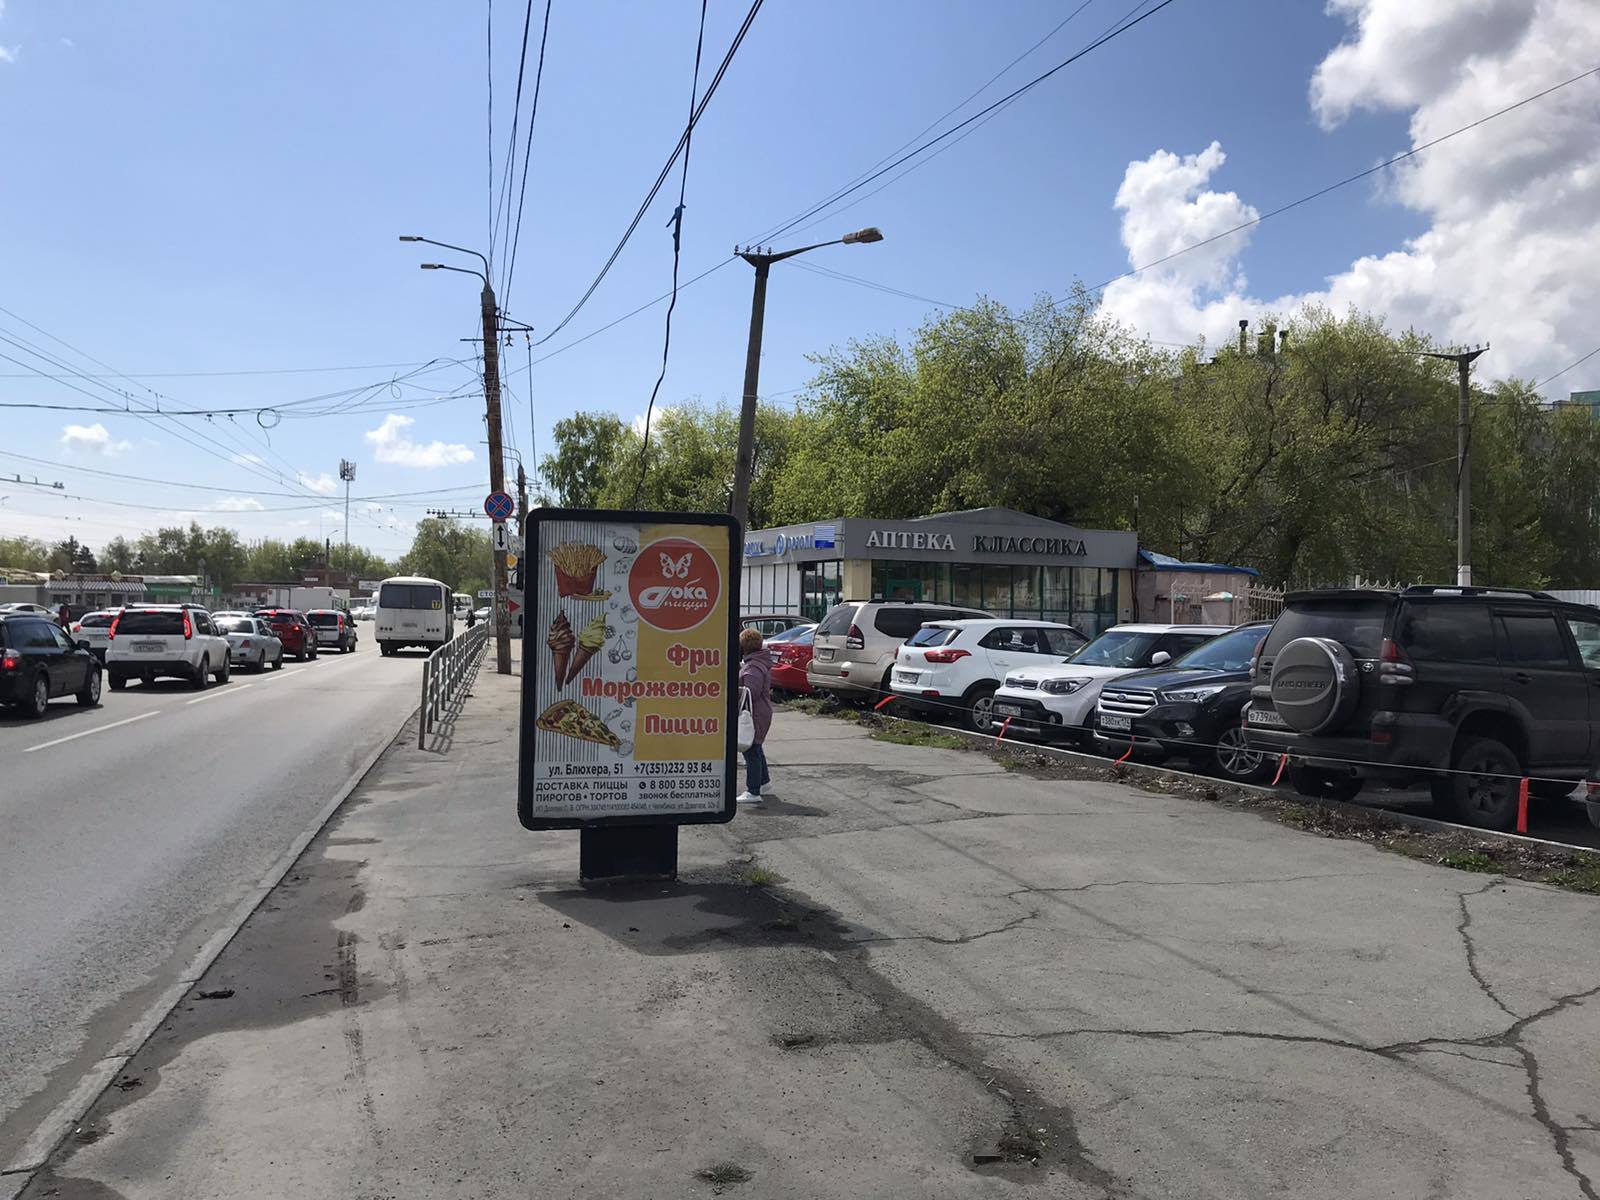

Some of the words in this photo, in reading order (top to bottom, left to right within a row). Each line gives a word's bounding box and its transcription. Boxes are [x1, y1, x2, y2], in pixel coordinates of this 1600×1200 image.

[866, 530, 956, 551] АПТЕКА
[973, 535, 1088, 556] КЛАССИКА
[667, 643, 721, 674] Фри
[582, 677, 721, 704] Мороженое
[645, 714, 719, 735] Пицца
[548, 765, 563, 777] ул.
[565, 763, 611, 776] Блюхера,
[613, 763, 624, 775] 51
[634, 762, 685, 775] +7(351)232
[687, 762, 699, 773] 93
[700, 762, 712, 773] 84
[536, 782, 589, 792] ДОСТАВКА
[593, 781, 628, 790] ПИЦЦЫ
[649, 780, 656, 789] 8
[658, 780, 676, 789] 800
[678, 779, 696, 789] 550
[698, 779, 720, 789] 8330
[536, 793, 582, 802] ПИРОГОВ
[590, 792, 628, 801] ТОРТОВ
[638, 792, 668, 800] звонок
[670, 789, 720, 799] бесплатный
